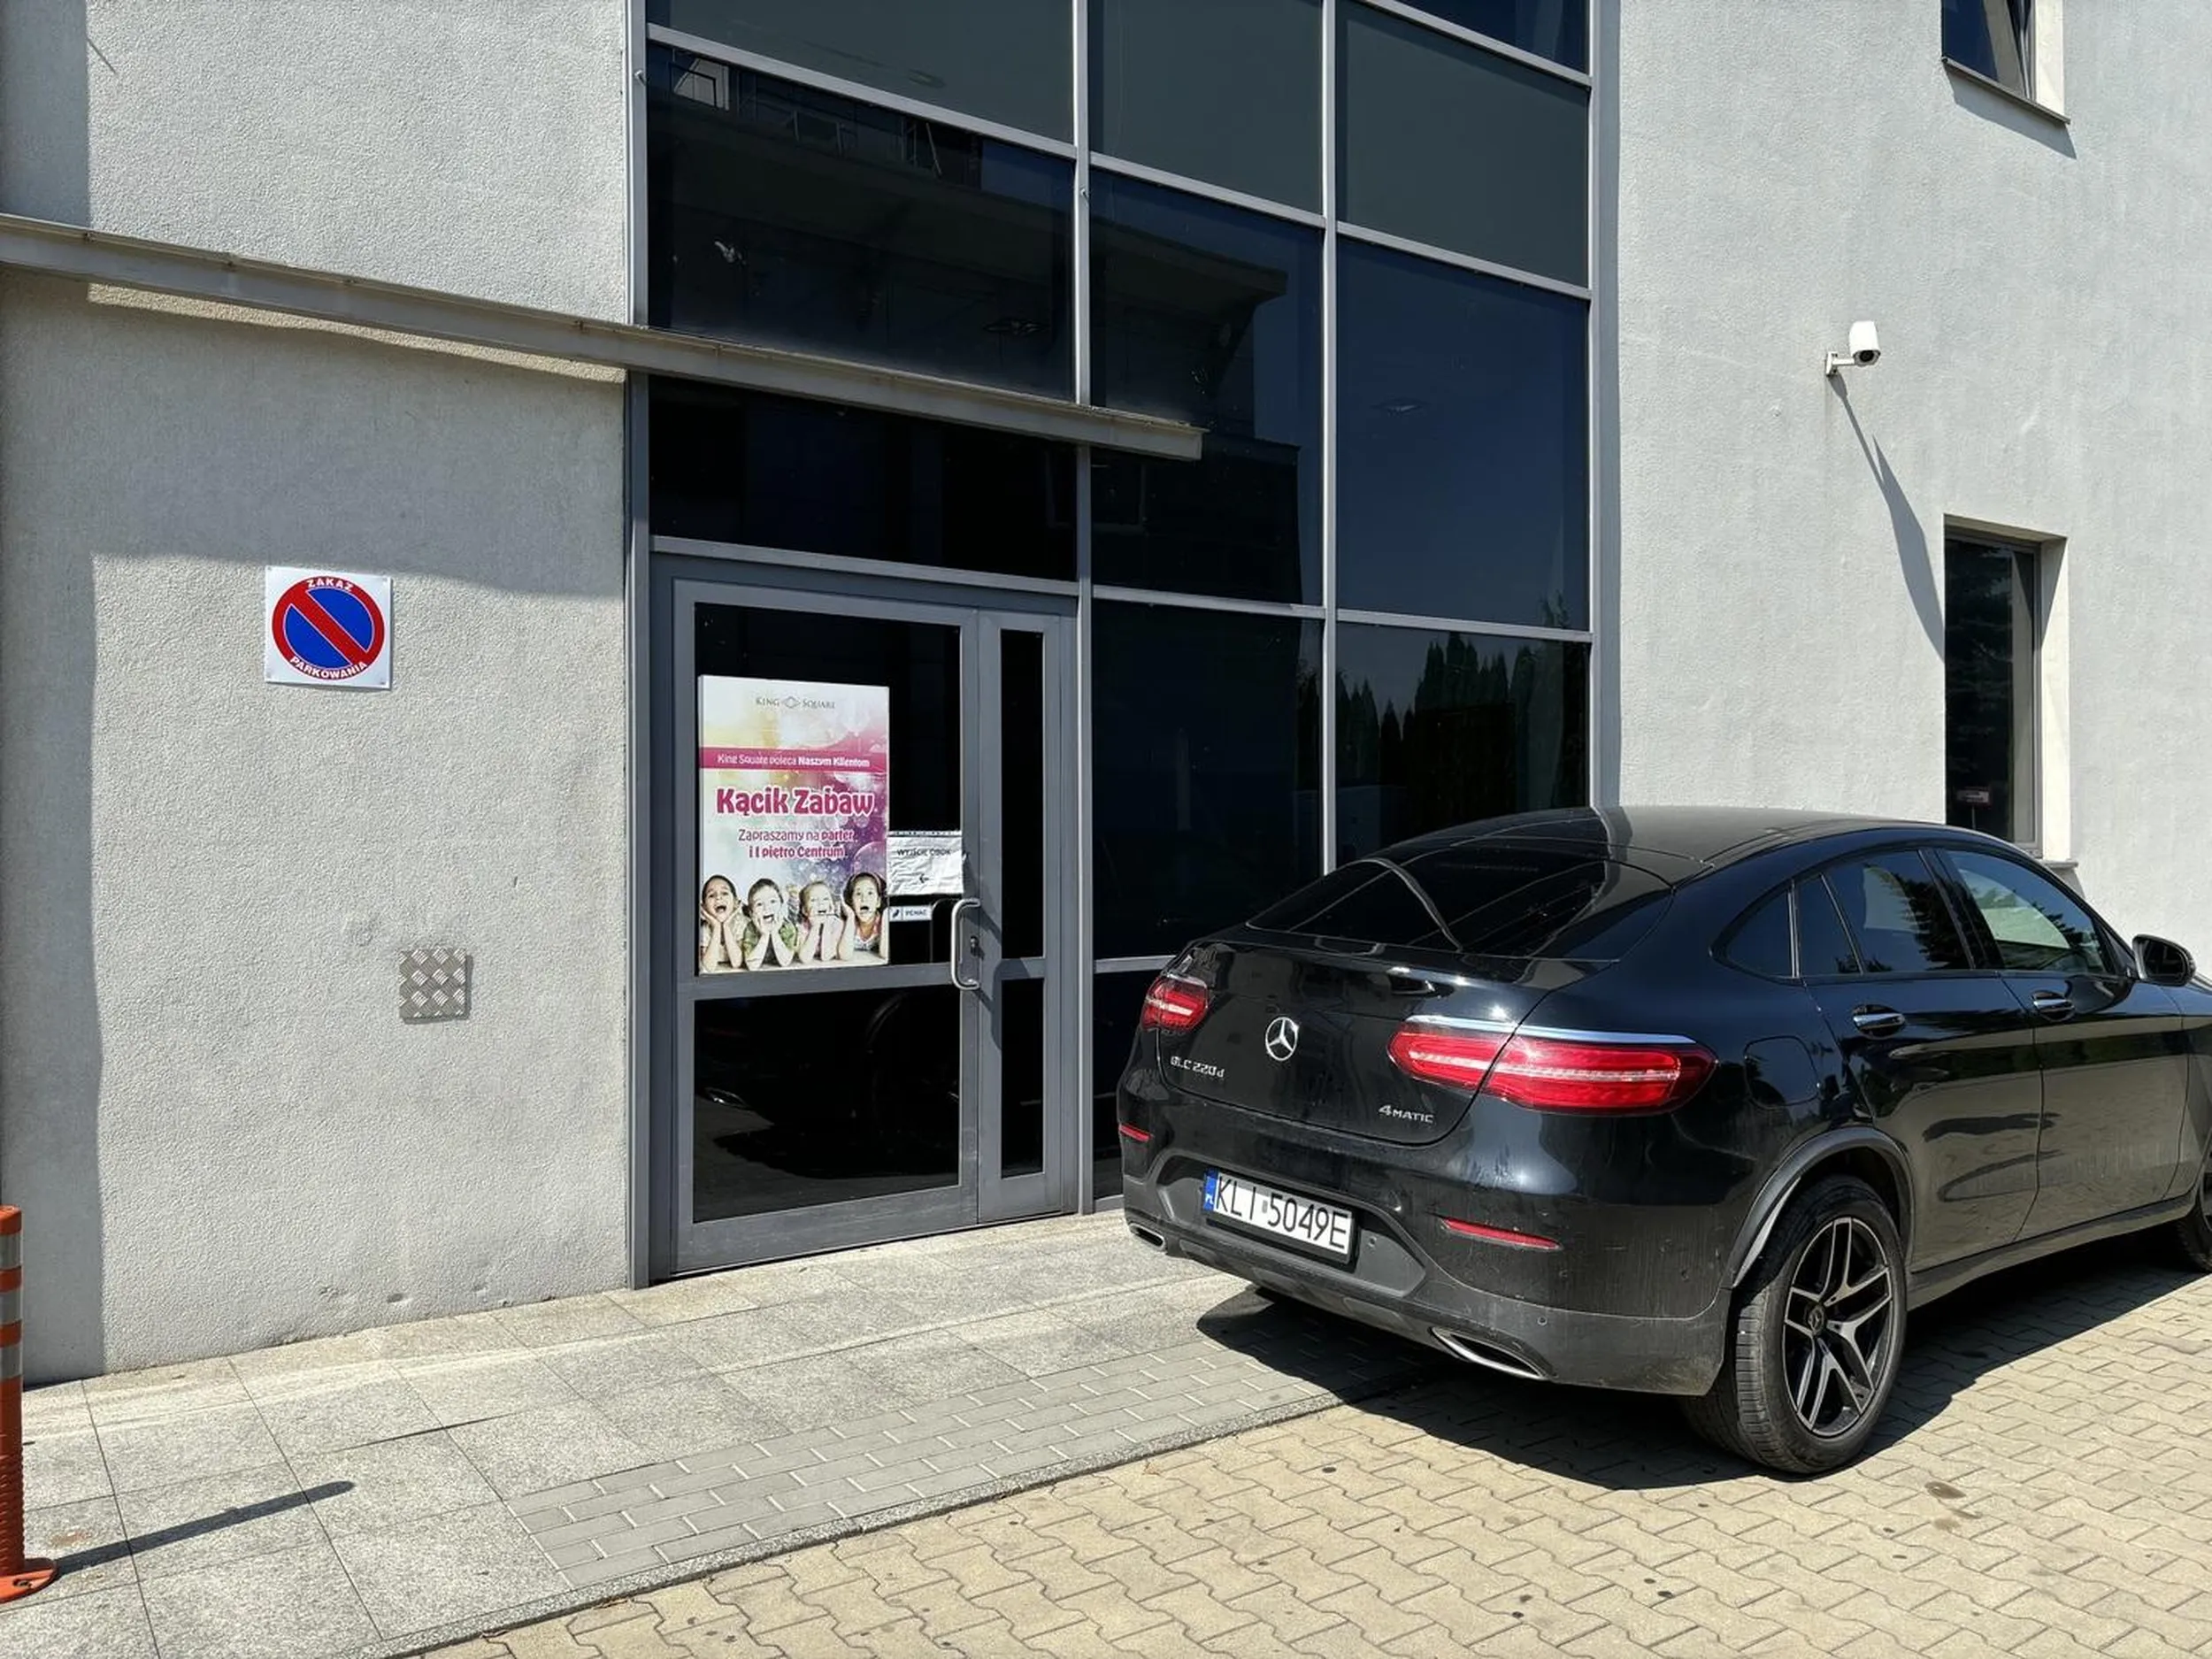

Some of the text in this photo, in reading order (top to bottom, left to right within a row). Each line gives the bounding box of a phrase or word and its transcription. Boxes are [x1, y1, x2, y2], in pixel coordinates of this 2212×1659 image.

[306, 578, 354, 592] ZAKAZ
[289, 655, 368, 679] PARKOWANIA
[756, 696, 780, 707] KING
[718, 754, 870, 768] King Square poleca Naszym Klientom
[717, 785, 873, 816] Kącik Zabaw
[738, 829, 804, 842] Zapraszamy
[805, 830, 819, 841] na
[761, 845, 795, 859] piętro
[1171, 1056, 1225, 1078] GLC 220d
[1378, 1104, 1433, 1124] 4MATIC
[1216, 1176, 1348, 1248] KLI 5049E
